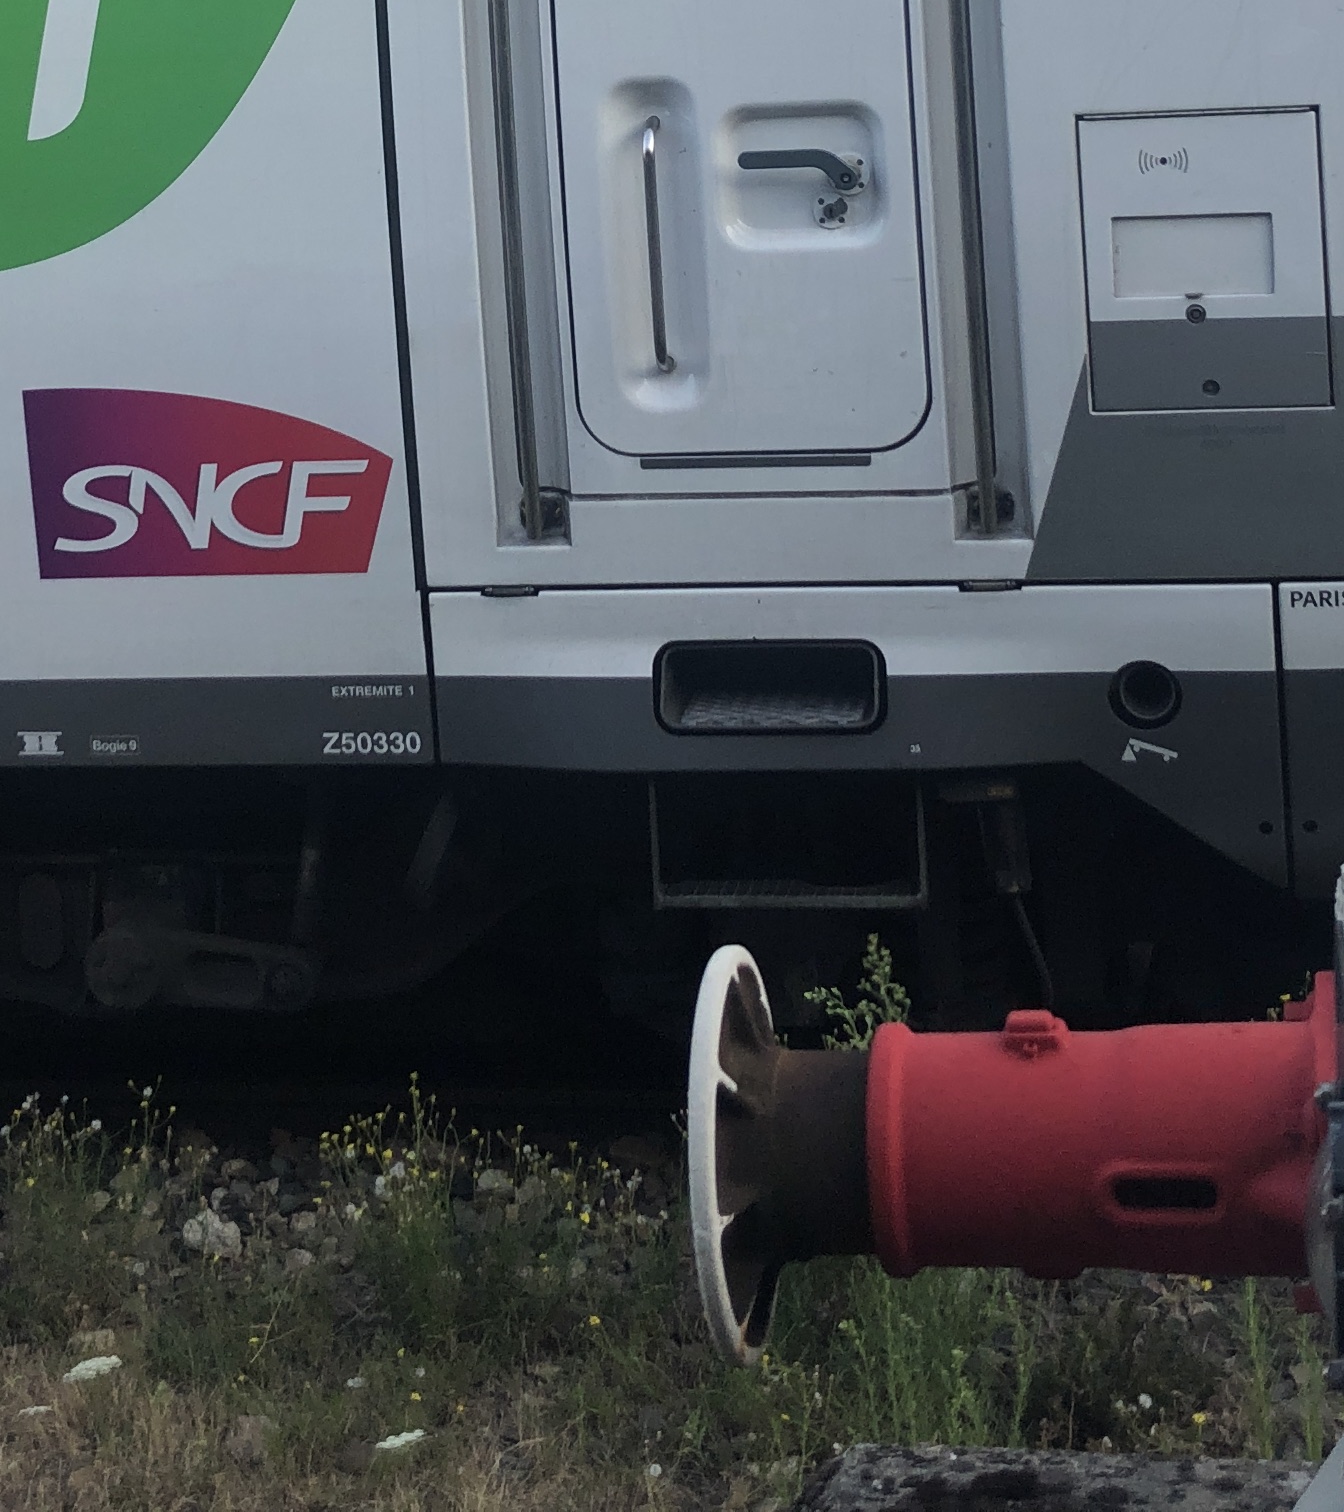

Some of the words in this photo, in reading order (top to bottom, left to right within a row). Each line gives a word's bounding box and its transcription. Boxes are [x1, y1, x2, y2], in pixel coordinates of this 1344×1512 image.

[54, 458, 370, 553] SNCF
[331, 685, 403, 697] EXTREMITE
[92, 739, 128, 753] Bogie
[322, 731, 422, 755] Z50330
